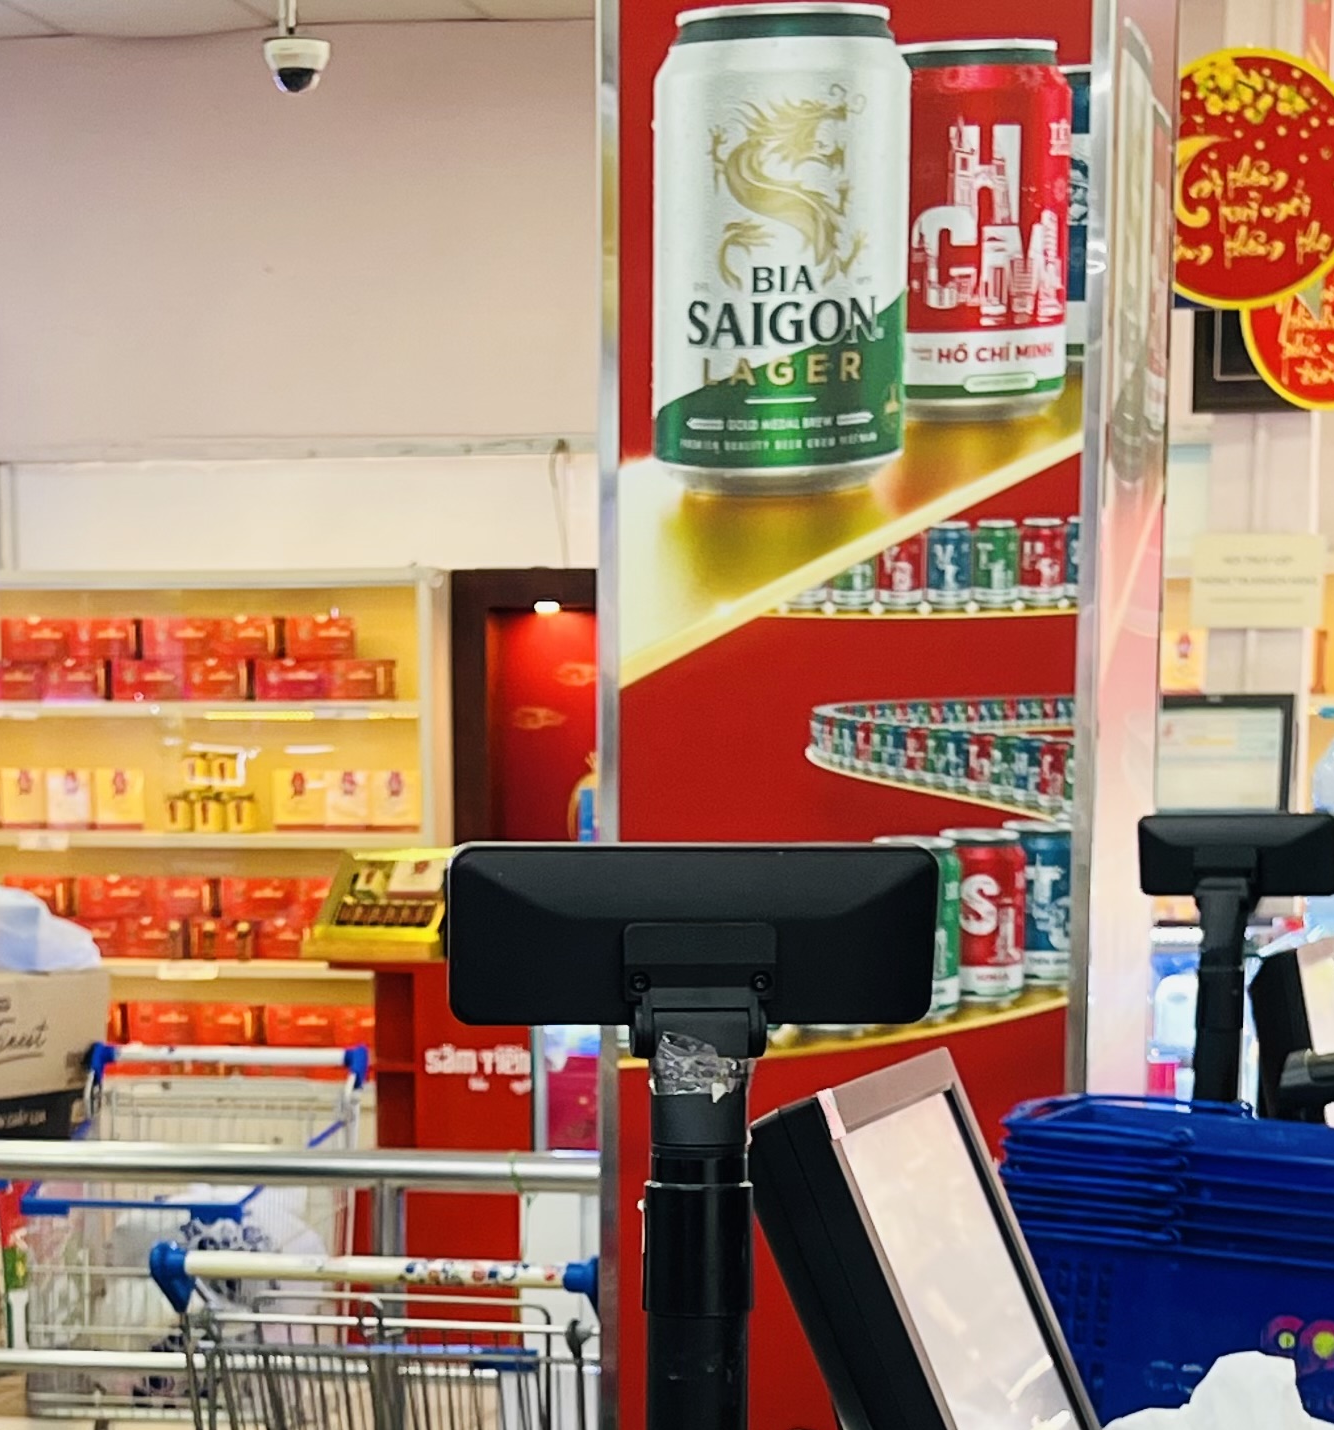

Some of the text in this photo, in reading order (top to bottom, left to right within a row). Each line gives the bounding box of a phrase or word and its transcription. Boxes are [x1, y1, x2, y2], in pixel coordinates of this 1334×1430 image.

[751, 265, 816, 294] BIA
[686, 295, 878, 348] SAIGON
[937, 341, 969, 363] HỒ
[975, 340, 1010, 362] CHÍ
[1015, 342, 1054, 360] MINH
[702, 351, 863, 387] LAGER
